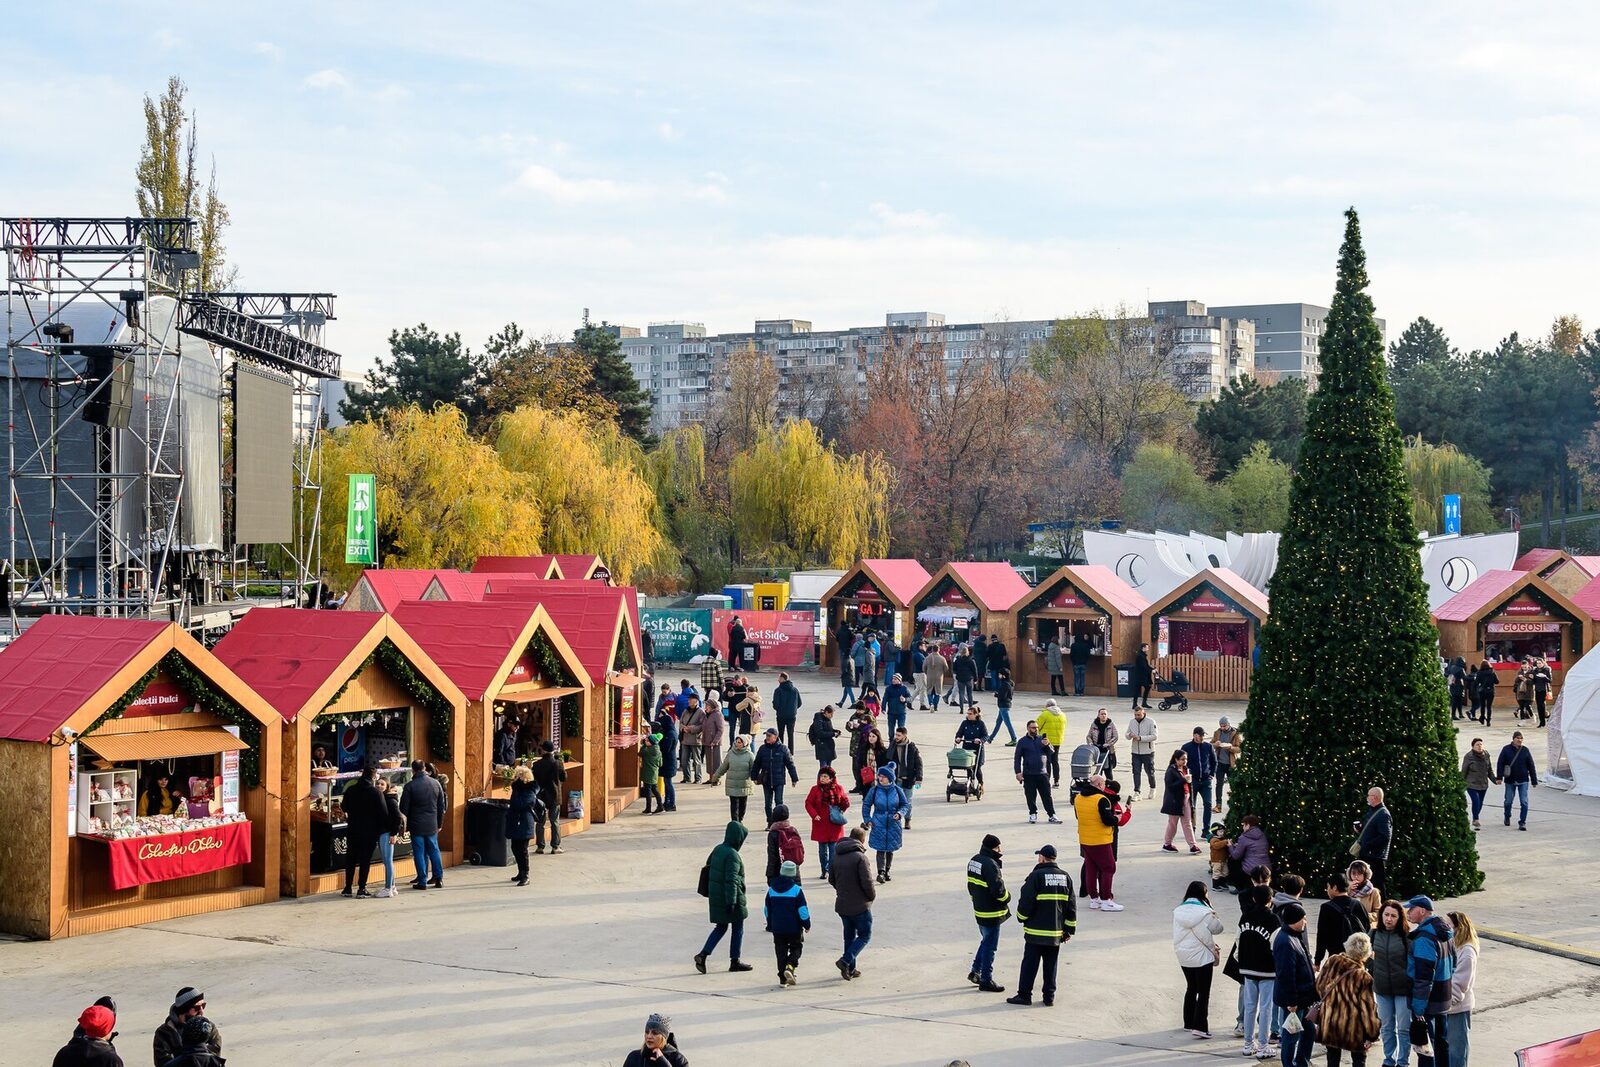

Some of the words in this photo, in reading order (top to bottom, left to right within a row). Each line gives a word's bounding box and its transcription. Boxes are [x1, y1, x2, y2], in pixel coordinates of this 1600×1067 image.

[348, 546, 369, 556] EXIT
[665, 617, 702, 635] Side
[1503, 622, 1544, 632] GOGOSI
[764, 629, 790, 642] Side
[158, 694, 179, 704] Dulci
